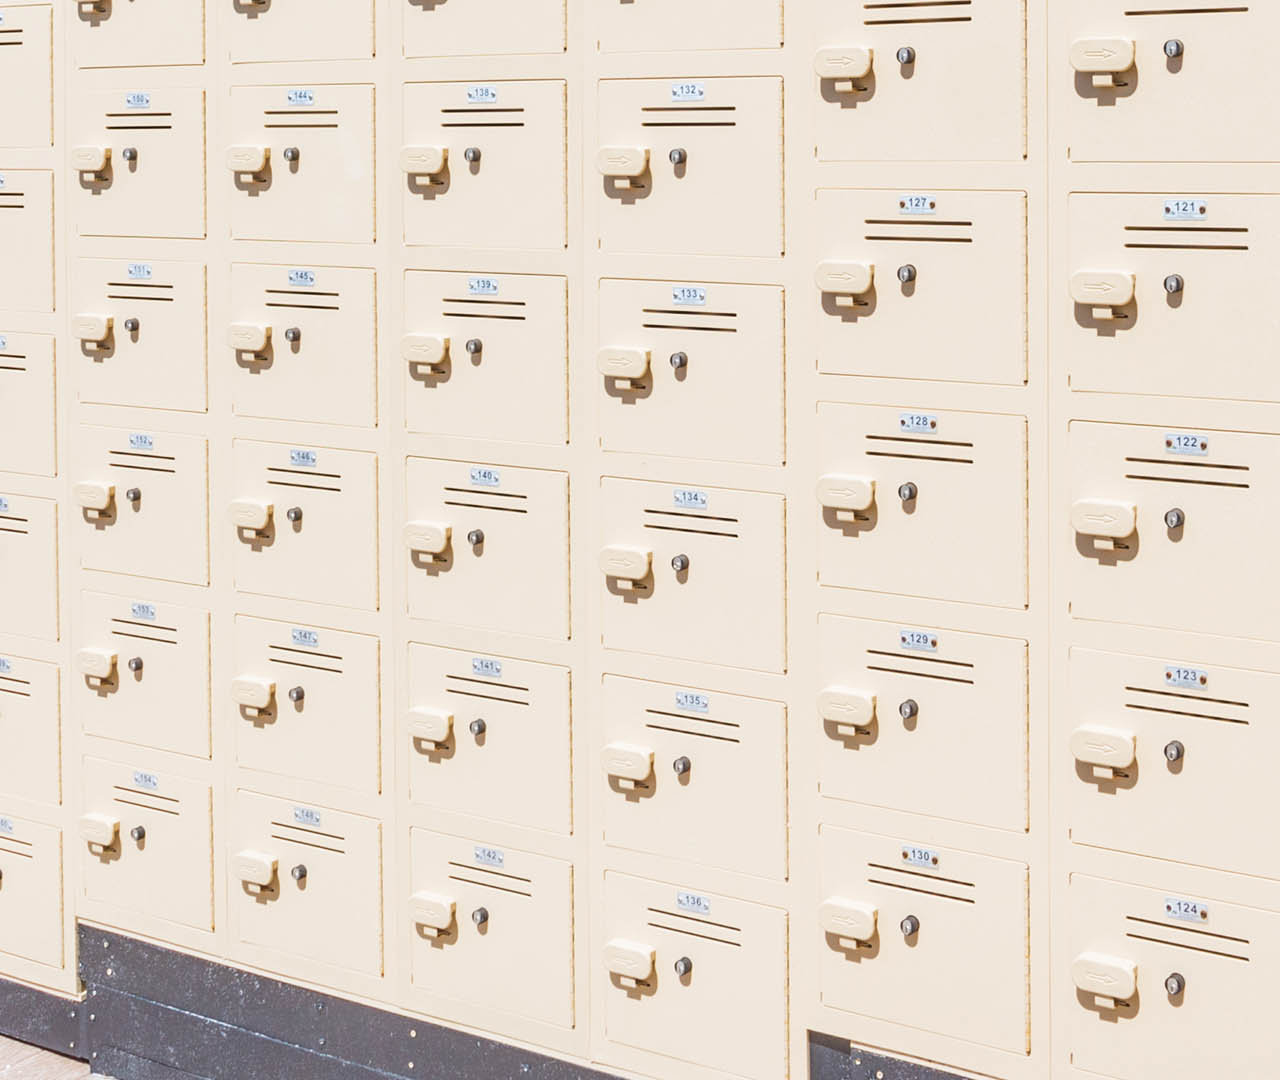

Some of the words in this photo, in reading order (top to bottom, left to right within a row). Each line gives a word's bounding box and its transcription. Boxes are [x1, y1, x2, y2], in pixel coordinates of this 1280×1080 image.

[475, 88, 489, 96] 138
[680, 85, 696, 94] 132
[909, 197, 927, 207] 127
[1175, 202, 1194, 212] 121
[296, 272, 308, 280] 145
[477, 280, 491, 288] 139
[681, 289, 697, 298] 133
[910, 416, 928, 426] 128
[136, 435, 147, 444] 152
[1176, 437, 1197, 447] 122
[297, 452, 310, 460] 146
[478, 471, 492, 480] 140
[683, 492, 698, 501] 134
[299, 631, 312, 640] 147
[910, 633, 928, 644] 129
[480, 661, 493, 670] 141
[1176, 669, 1196, 681] 123
[684, 695, 700, 705] 135
[482, 849, 496, 860] 142
[912, 849, 930, 861] 130
[686, 896, 701, 906] 136
[1177, 902, 1197, 914] 124
